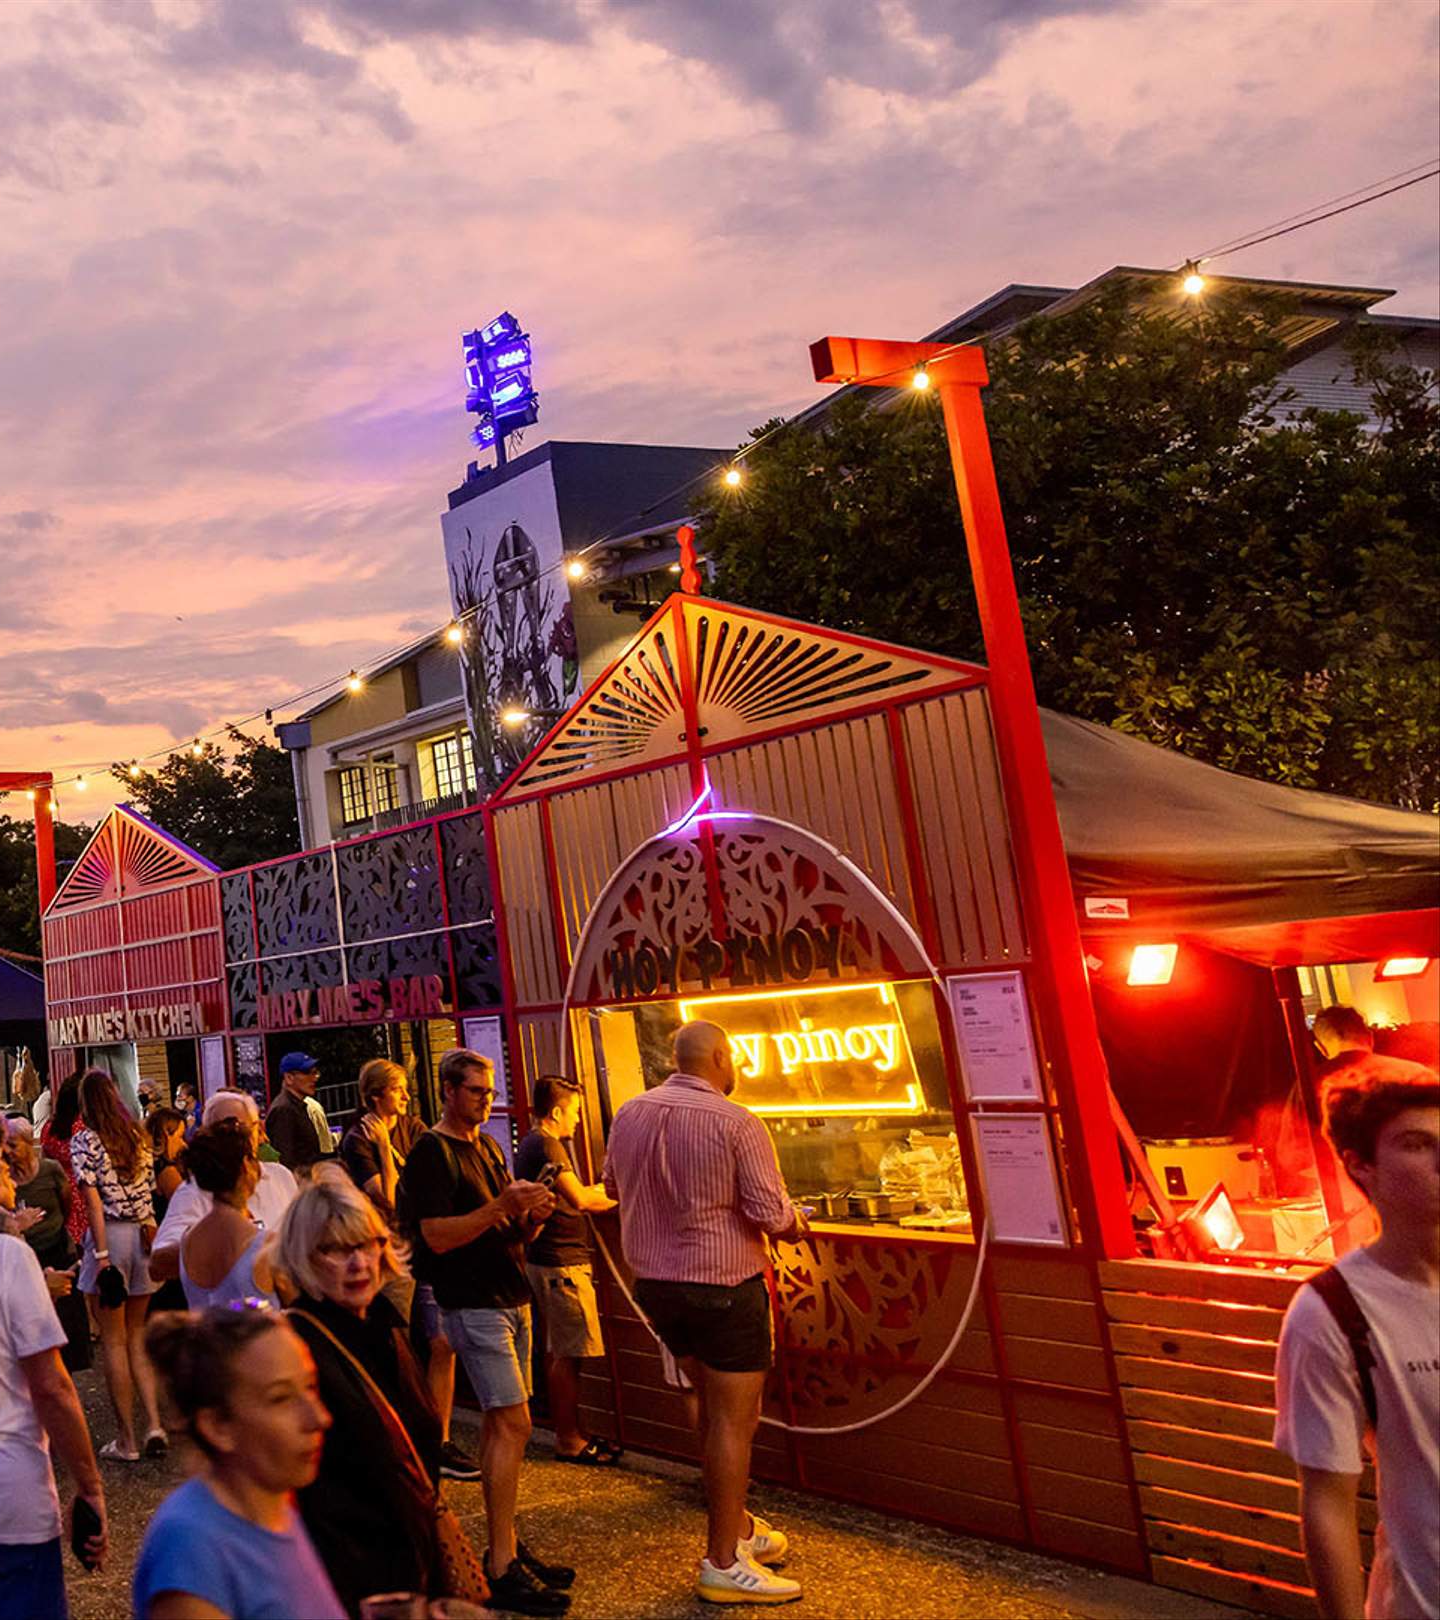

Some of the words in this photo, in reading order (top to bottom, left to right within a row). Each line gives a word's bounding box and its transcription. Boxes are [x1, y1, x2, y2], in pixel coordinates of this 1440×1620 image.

[611, 944, 680, 998] HOY
[694, 924, 842, 990] PINOY
[48, 1015, 84, 1046] MARY
[86, 1006, 125, 1042] MAE'S
[126, 1002, 205, 1039] KITCHEN
[260, 989, 310, 1029] MARY
[317, 979, 385, 1023] MAE'S
[389, 975, 446, 1017] BAR
[771, 1018, 898, 1075] pinoy
